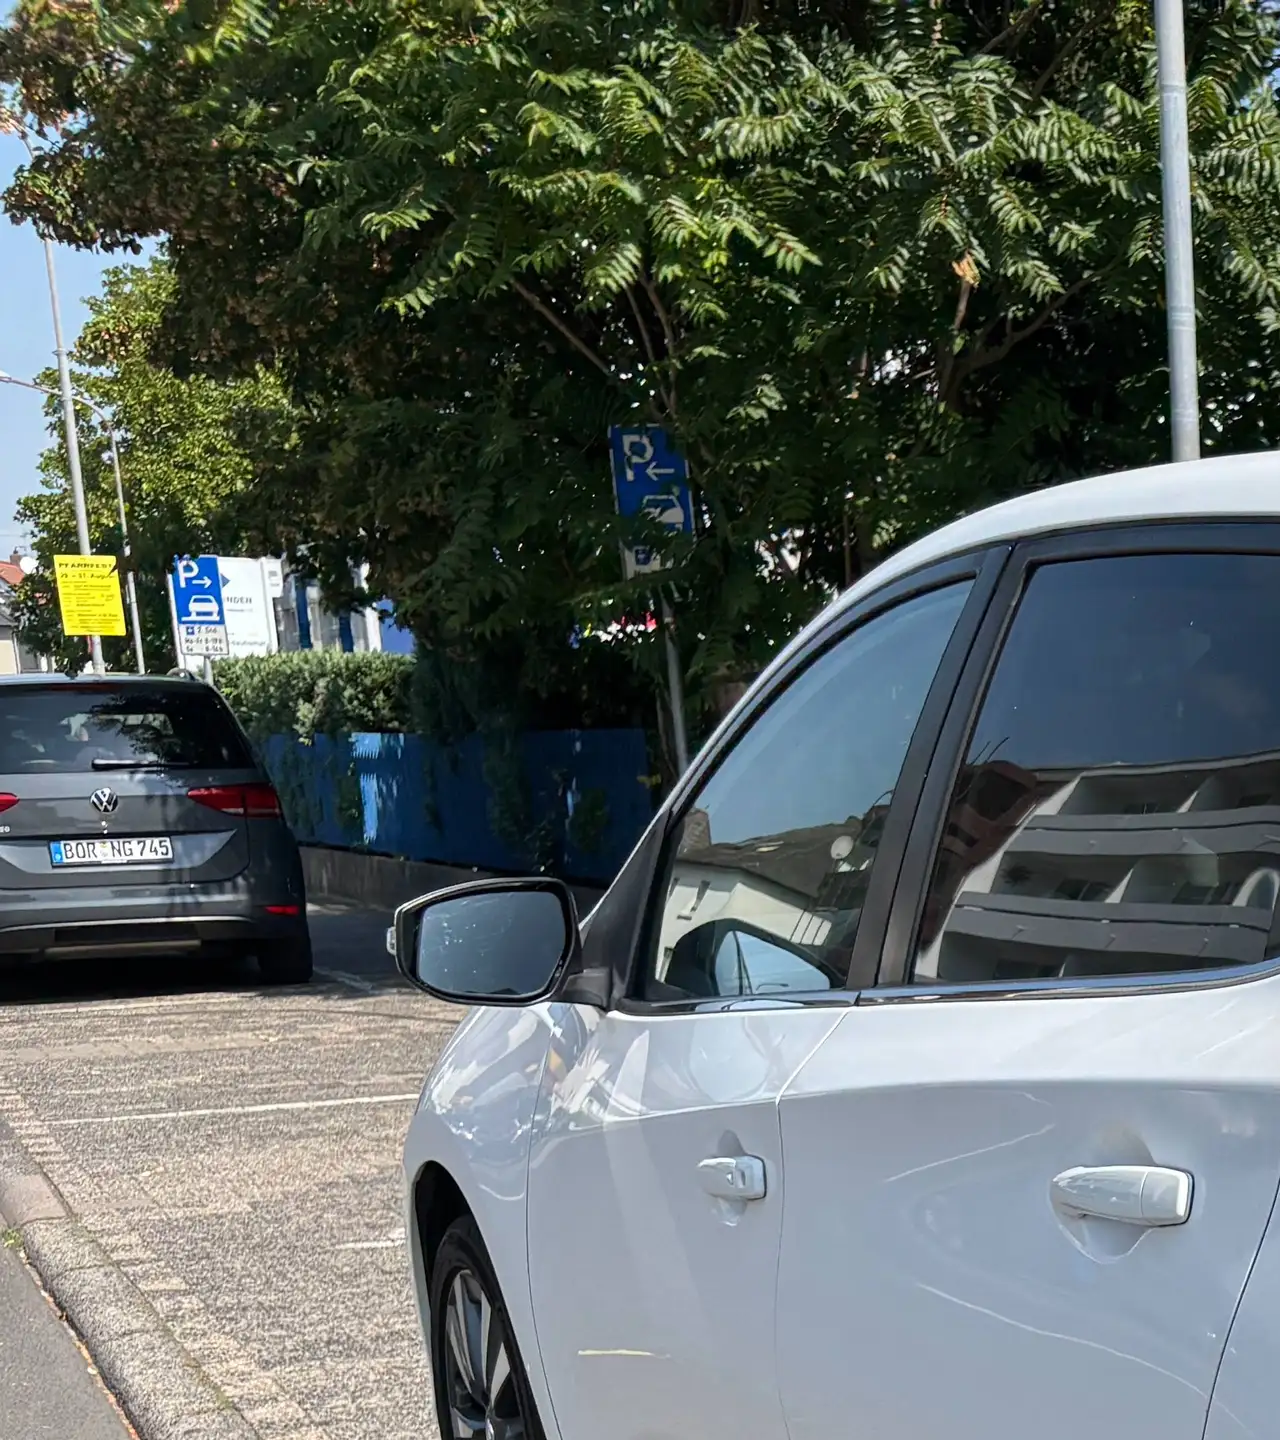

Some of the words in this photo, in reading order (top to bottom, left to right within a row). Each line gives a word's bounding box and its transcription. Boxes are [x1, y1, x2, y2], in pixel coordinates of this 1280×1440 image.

[177, 560, 199, 589] P
[63, 842, 97, 860] BOR
[110, 840, 133, 858] NG
[137, 839, 169, 857] 745
